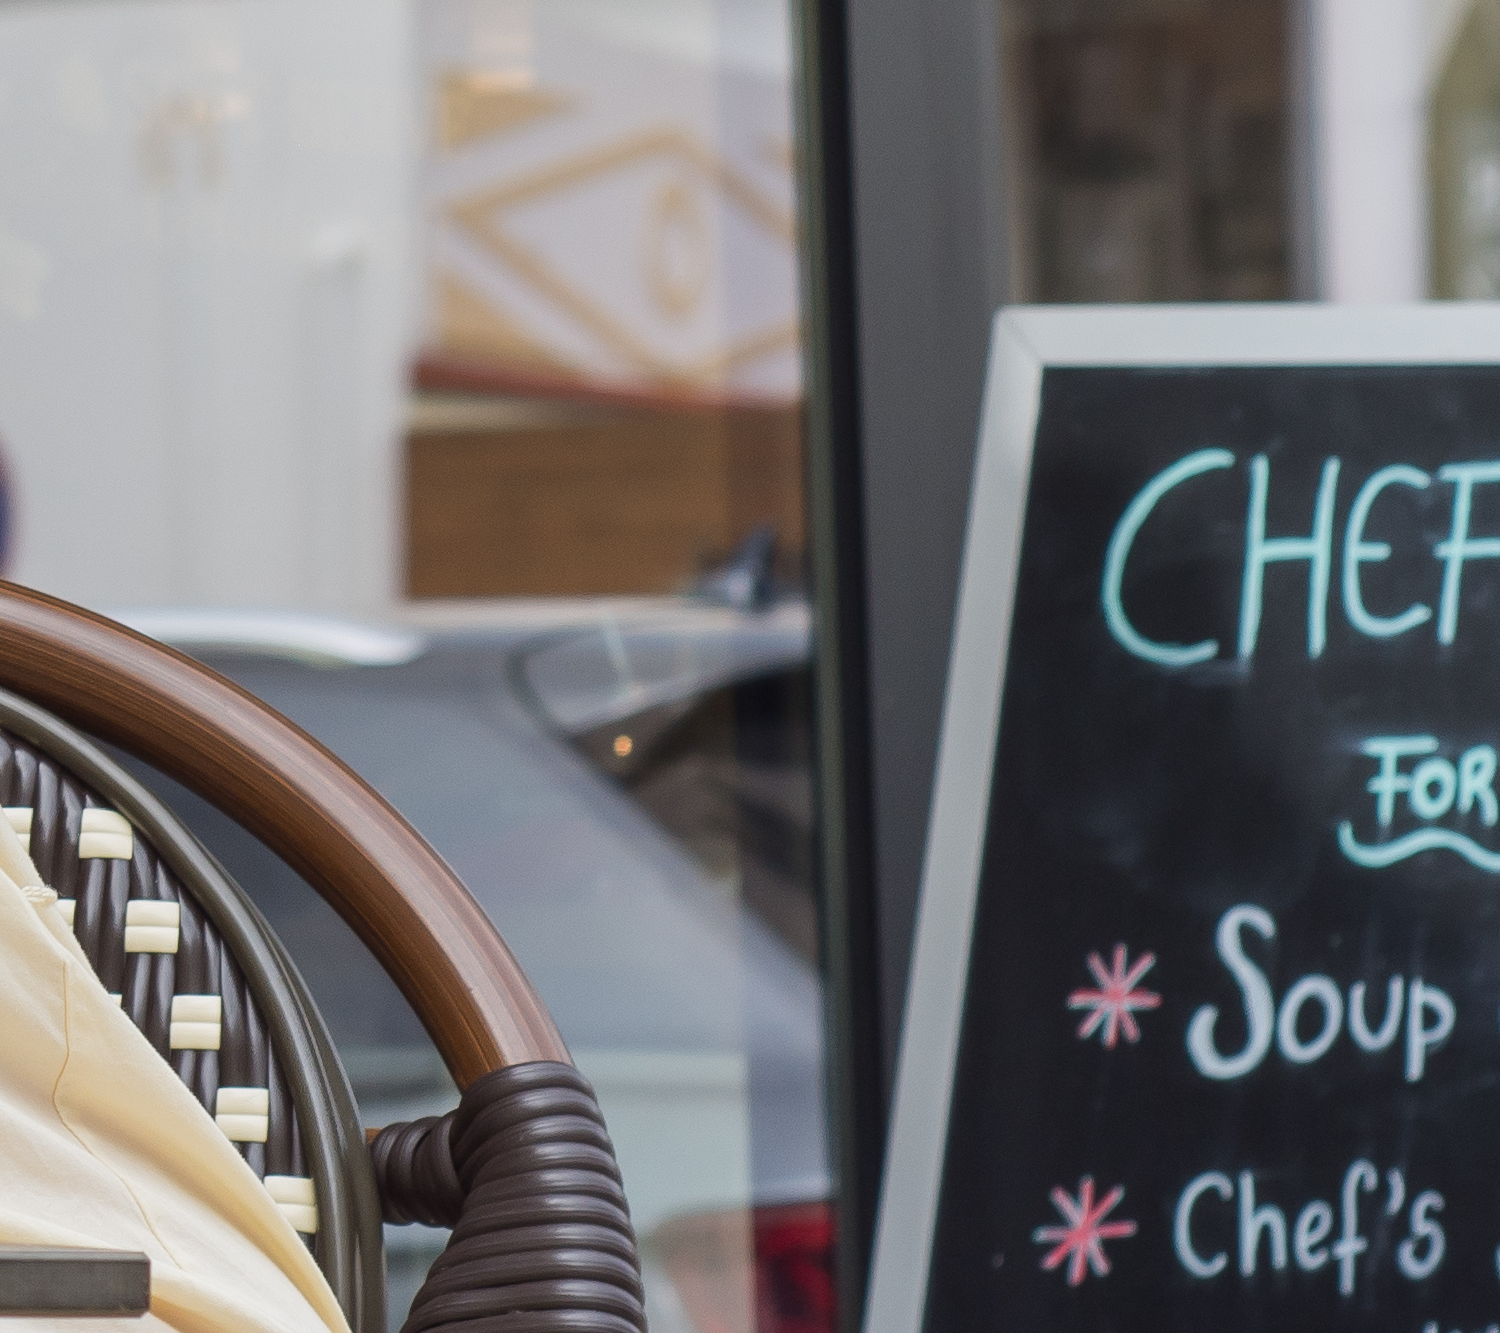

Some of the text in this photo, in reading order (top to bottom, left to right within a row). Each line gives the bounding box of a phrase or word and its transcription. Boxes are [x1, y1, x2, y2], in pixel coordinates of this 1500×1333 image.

[1360, 733, 1500, 828] FOR
[1185, 901, 1457, 1084] Soup
[1173, 1156, 1447, 1299] Chef's
